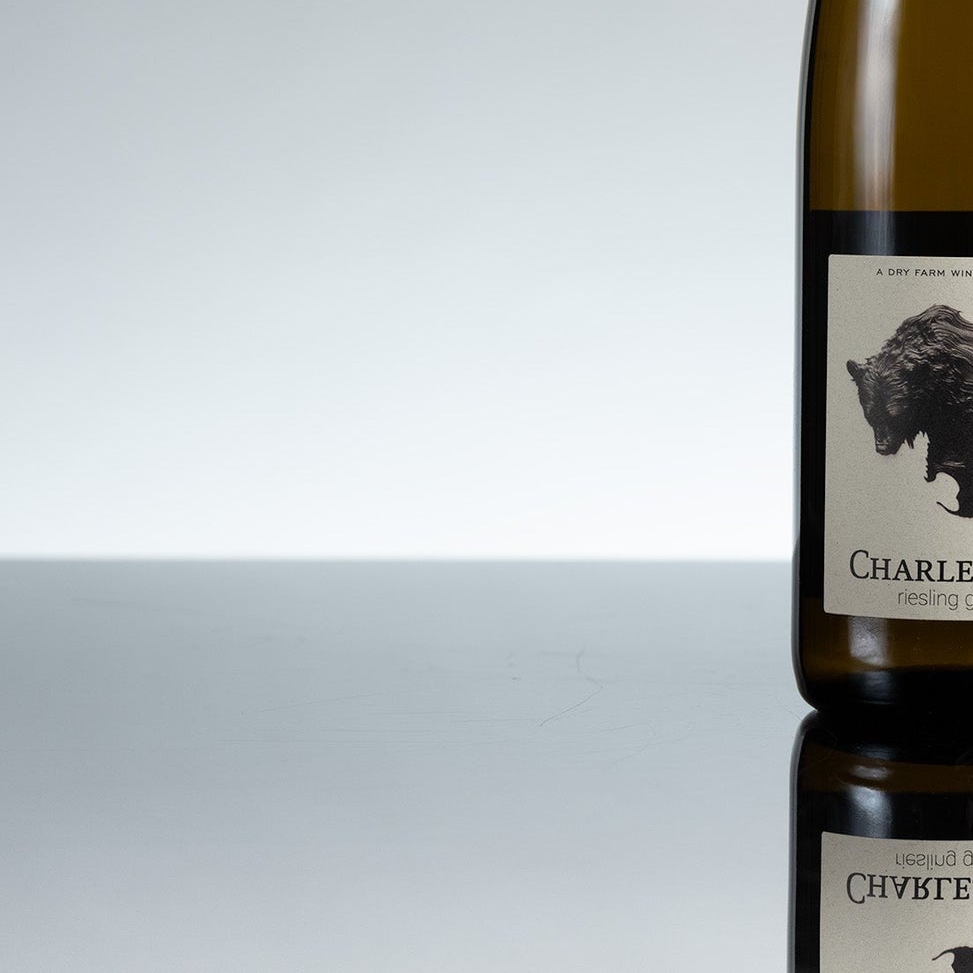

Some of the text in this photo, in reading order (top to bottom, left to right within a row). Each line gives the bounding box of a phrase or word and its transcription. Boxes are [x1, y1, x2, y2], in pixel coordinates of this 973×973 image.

[876, 268, 884, 276] A
[888, 268, 911, 277] DRY
[914, 269, 946, 277] FARM
[897, 588, 959, 611] riesling
